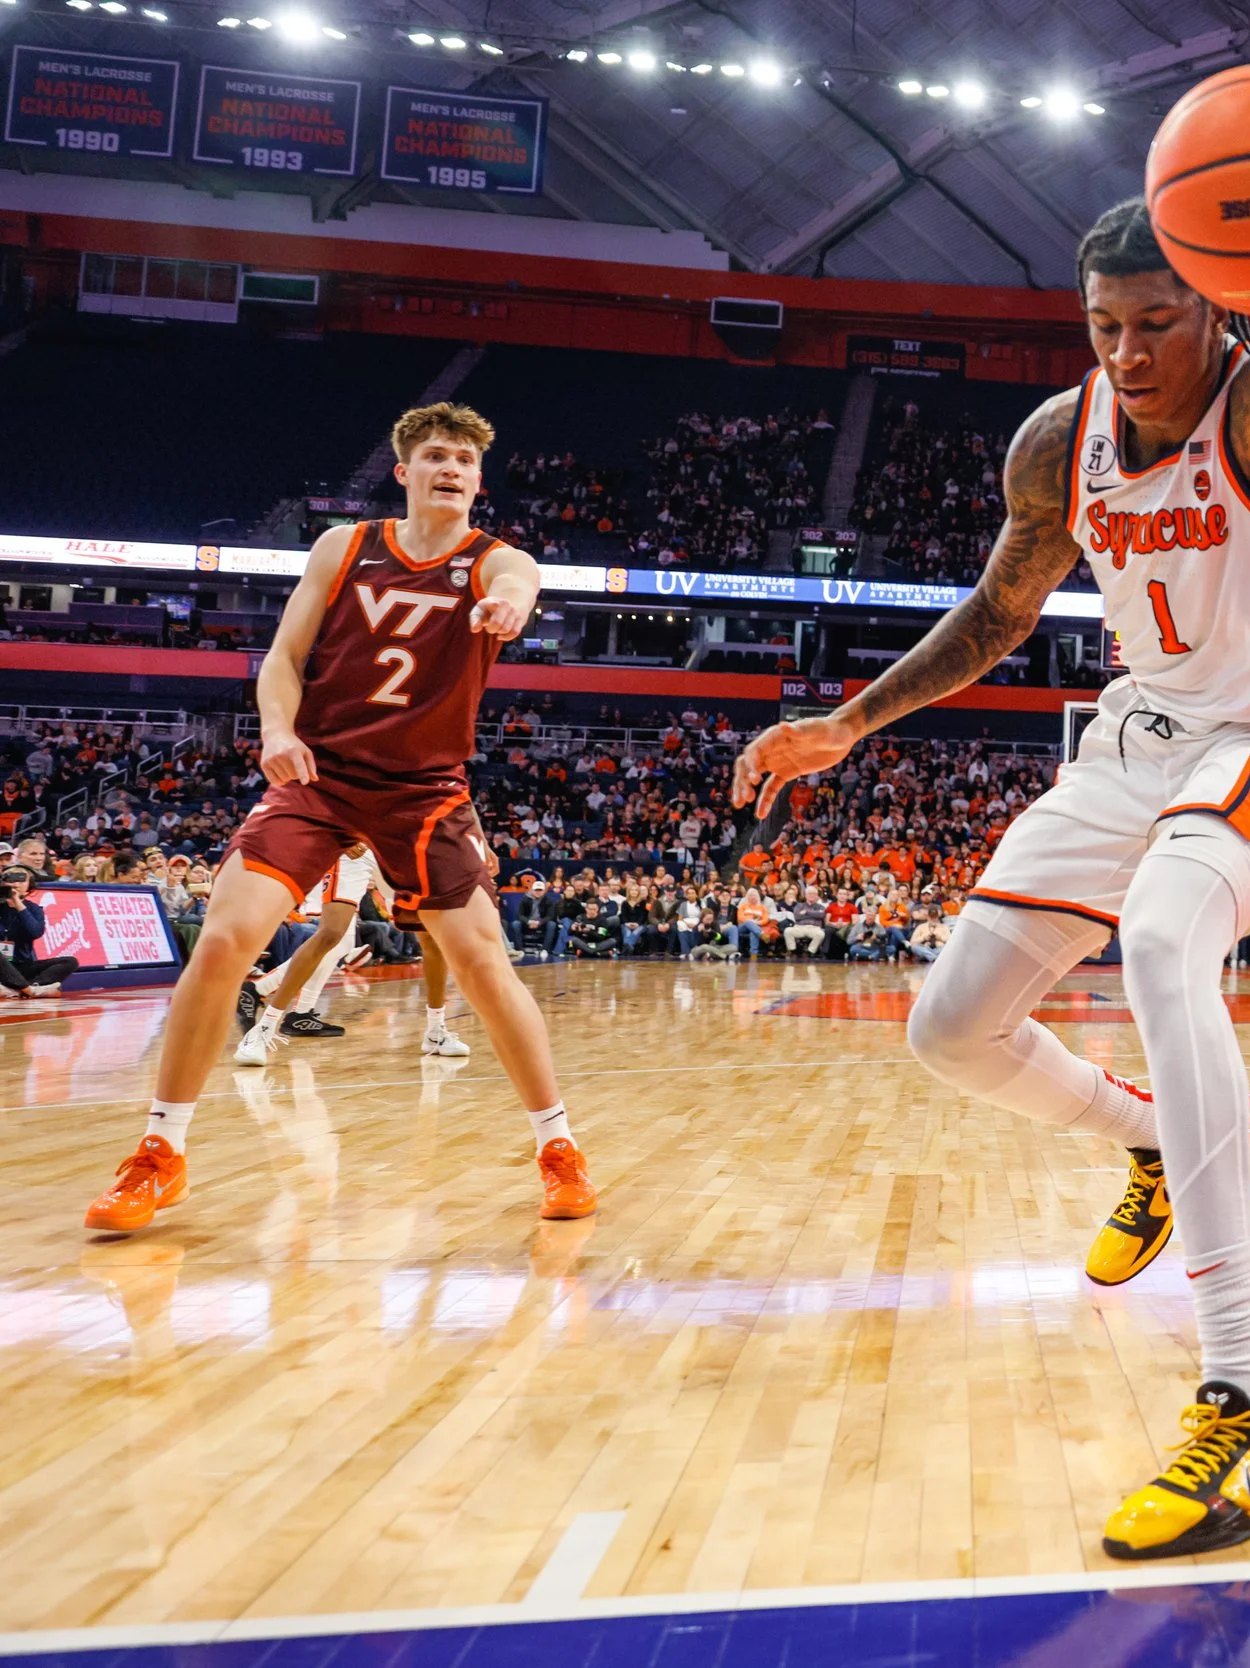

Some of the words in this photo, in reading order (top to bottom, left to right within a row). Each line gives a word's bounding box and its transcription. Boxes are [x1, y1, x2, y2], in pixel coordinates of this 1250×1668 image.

[38, 61, 81, 75] MEN'S
[84, 66, 153, 82] LACROSSE
[34, 77, 153, 107] NATIONAL
[225, 80, 266, 95] MEN'S
[269, 86, 335, 102] LACROSSE
[19, 95, 164, 128] CHAMPIONS
[221, 98, 336, 126] NATIONAL
[410, 102, 450, 116] MEN'S
[452, 107, 517, 122] LACROSSE
[55, 128, 120, 152] 1990
[207, 115, 347, 146] CHAMPIONS
[407, 118, 518, 145] NATIONAL
[241, 147, 303, 171] 1993
[394, 135, 528, 165] CHAMPIONS
[427, 166, 486, 189] 1995
[893, 340, 921, 352] TEXT
[1087, 453, 1103, 471] 21
[308, 500, 330, 511] 301
[802, 530, 824, 542] 302
[1086, 498, 1229, 571] Syracuse
[65, 540, 134, 554] HALE
[197, 546, 219, 571] S
[605, 567, 629, 593] S
[655, 570, 699, 596] UV
[704, 573, 757, 584] UNIVERSITY
[758, 576, 796, 587] VILLAGE
[704, 582, 796, 594] APARTMENTS
[821, 579, 866, 604] UV
[869, 582, 921, 594] UNIVERSITY
[922, 584, 958, 596] VILLAGE
[869, 591, 958, 602] APARTMENTS
[353, 581, 465, 639] VT
[1147, 579, 1192, 655] 1
[365, 645, 417, 708] 2
[782, 683, 807, 697] 102
[819, 682, 843, 696] 103
[93, 895, 155, 916] ELEVATED
[103, 918, 160, 939] STUDENT
[119, 941, 160, 962] LIVING
